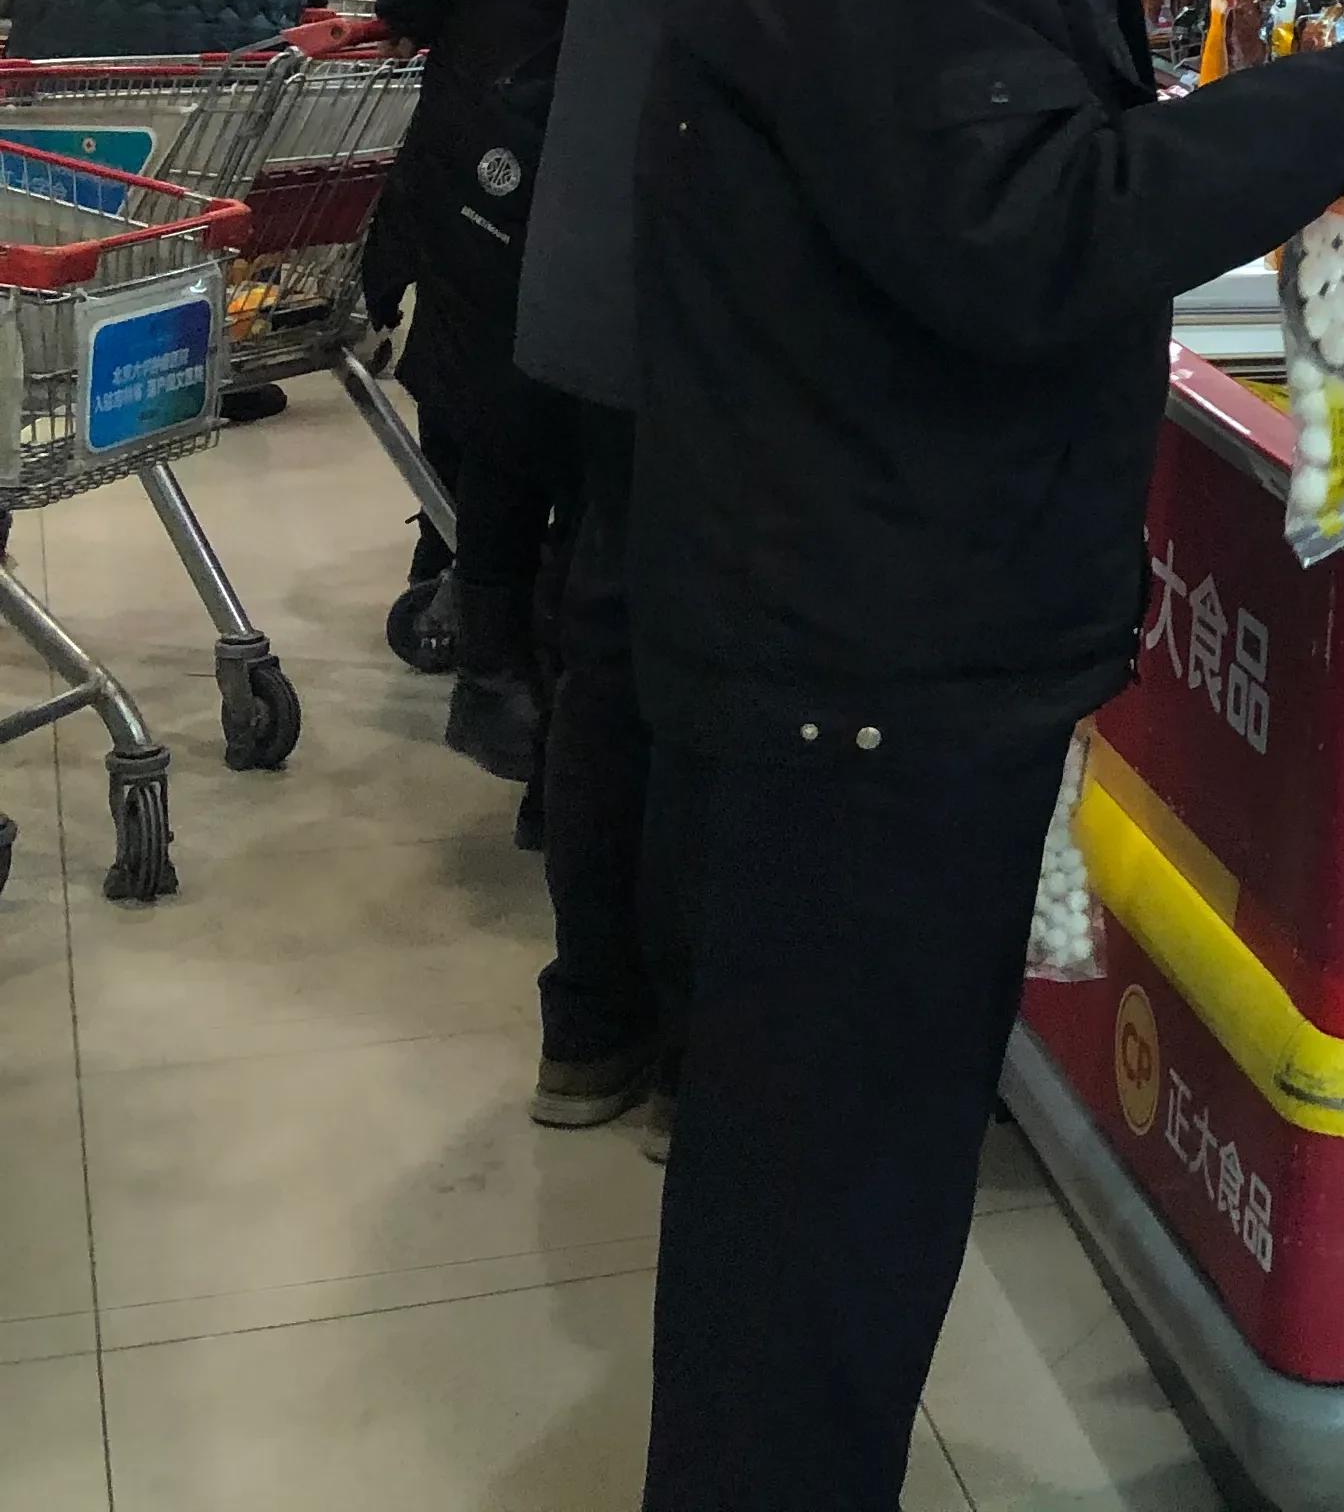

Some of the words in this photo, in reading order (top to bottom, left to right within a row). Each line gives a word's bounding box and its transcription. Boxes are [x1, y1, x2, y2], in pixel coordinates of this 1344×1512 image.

[1146, 540, 1270, 755] 大食品
[1121, 1020, 1152, 1084] CP
[1164, 1067, 1274, 1273] 正大食品
